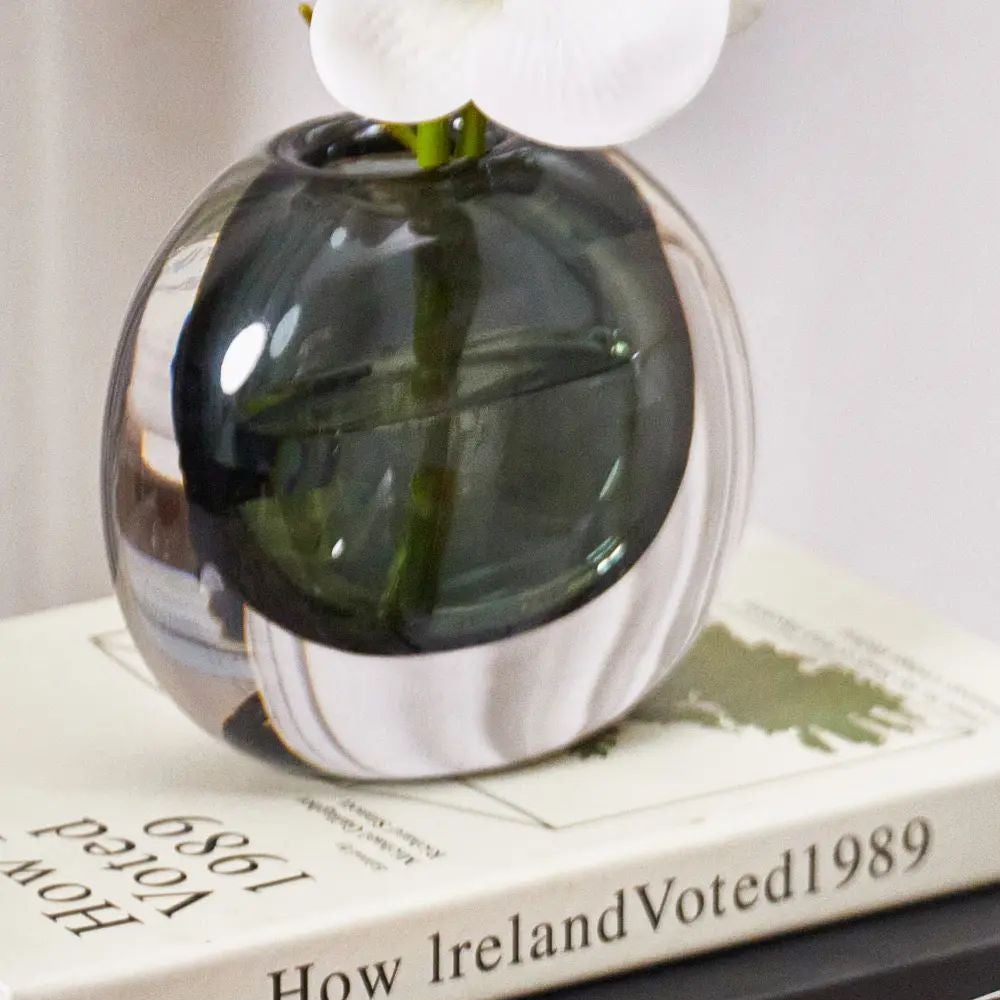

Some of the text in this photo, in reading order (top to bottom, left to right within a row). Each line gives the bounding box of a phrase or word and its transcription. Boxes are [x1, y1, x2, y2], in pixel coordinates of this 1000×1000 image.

[26, 816, 214, 919] Voted
[142, 815, 317, 893] 1989
[0, 858, 144, 938] How
